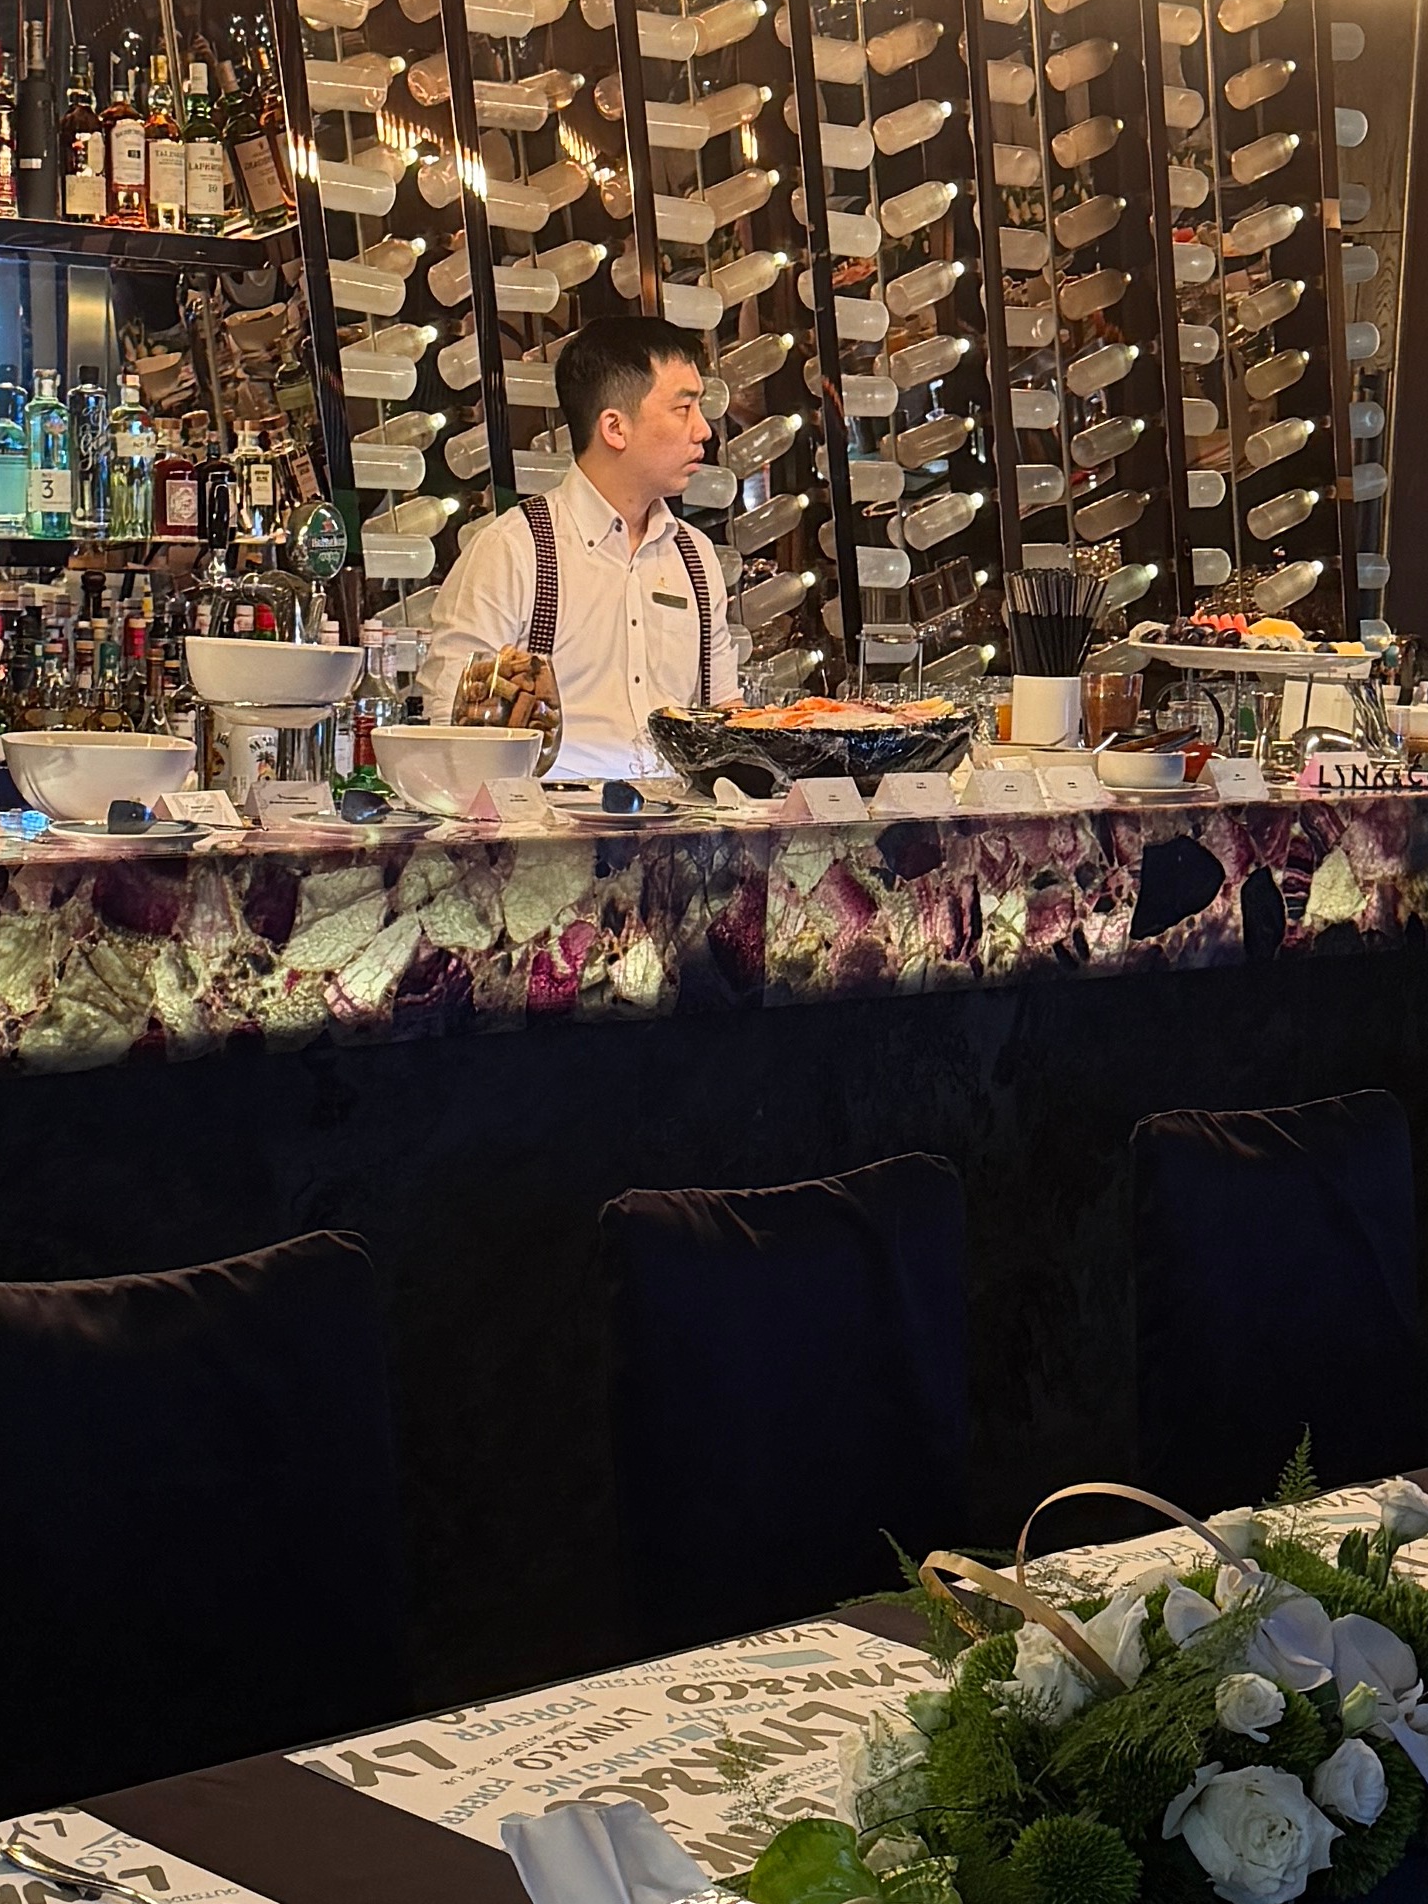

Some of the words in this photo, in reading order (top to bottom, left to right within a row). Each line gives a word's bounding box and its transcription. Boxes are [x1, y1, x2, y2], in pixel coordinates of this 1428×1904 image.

[443, 1695, 598, 1743] FOREVER
[512, 1705, 653, 1772] LYNK&CO
[522, 1733, 687, 1798] CHANGING
